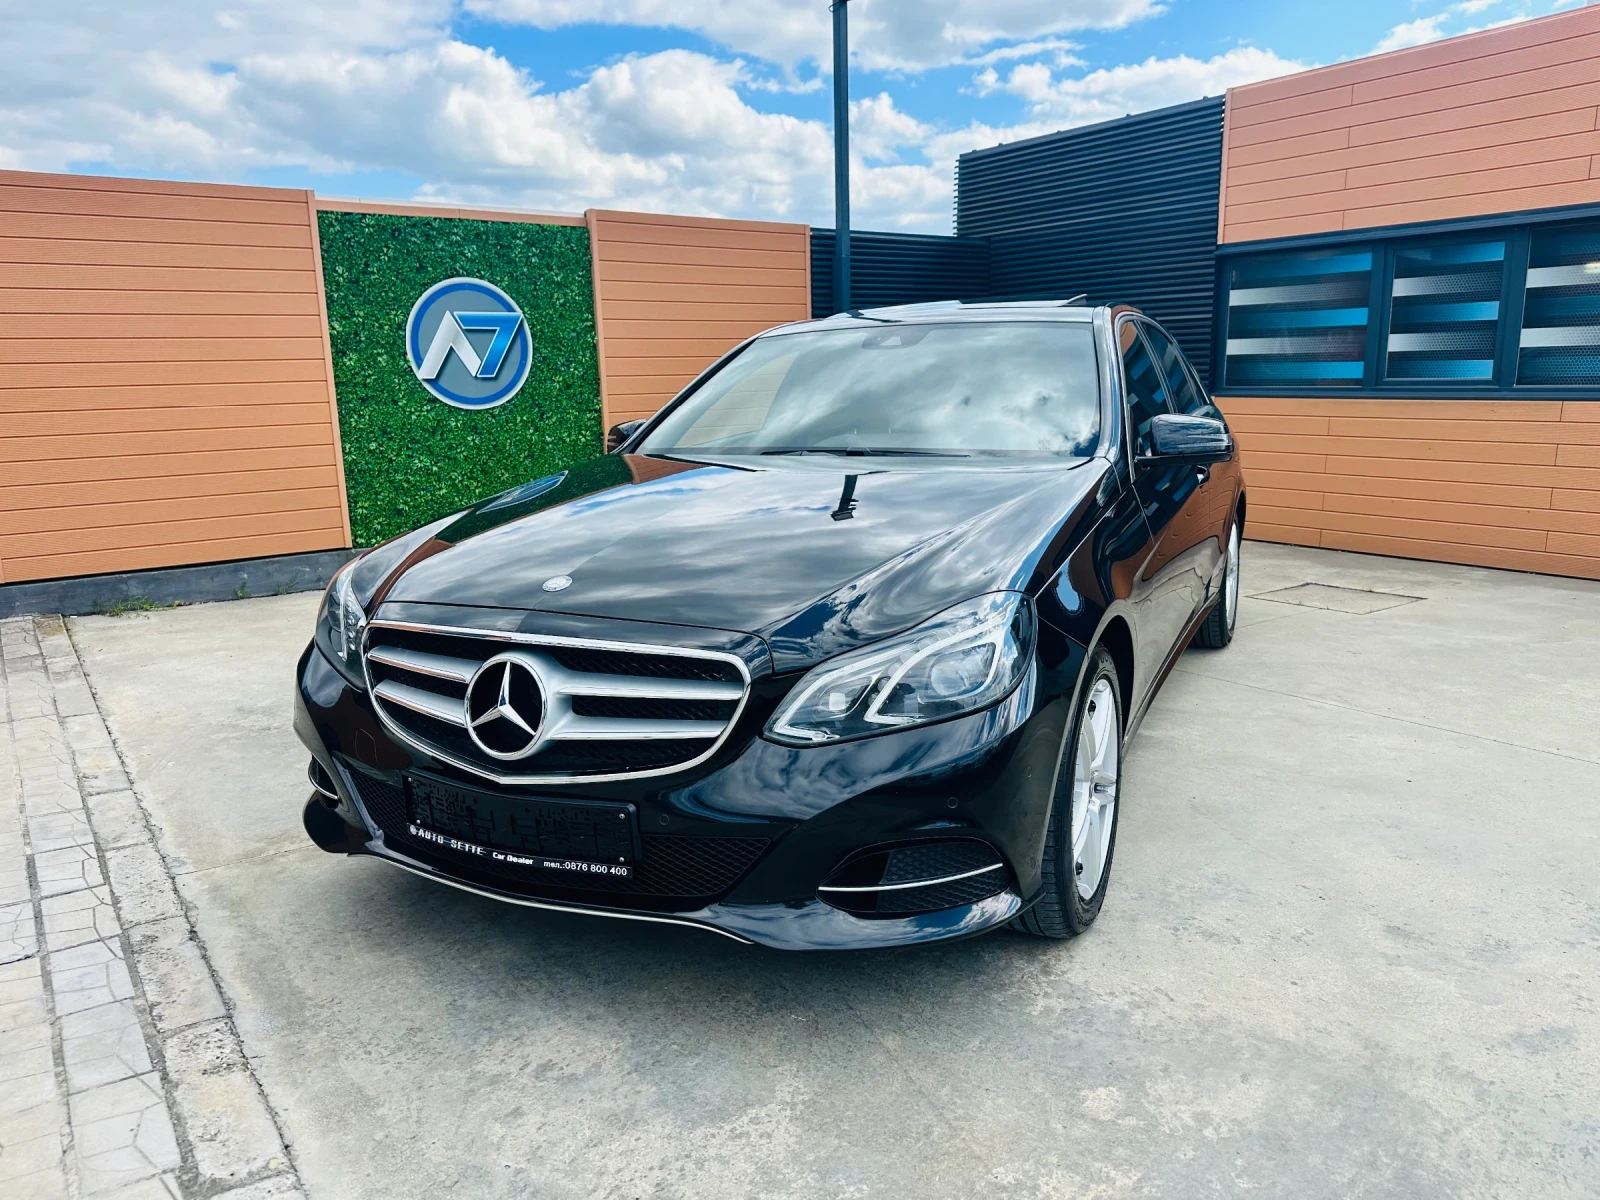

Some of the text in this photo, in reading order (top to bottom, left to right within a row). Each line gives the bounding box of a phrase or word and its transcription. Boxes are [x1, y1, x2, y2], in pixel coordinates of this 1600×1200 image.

[418, 828, 534, 865] AUTO SETTE Car Dealer
[590, 864, 608, 874] 800
[609, 866, 628, 876] 400
